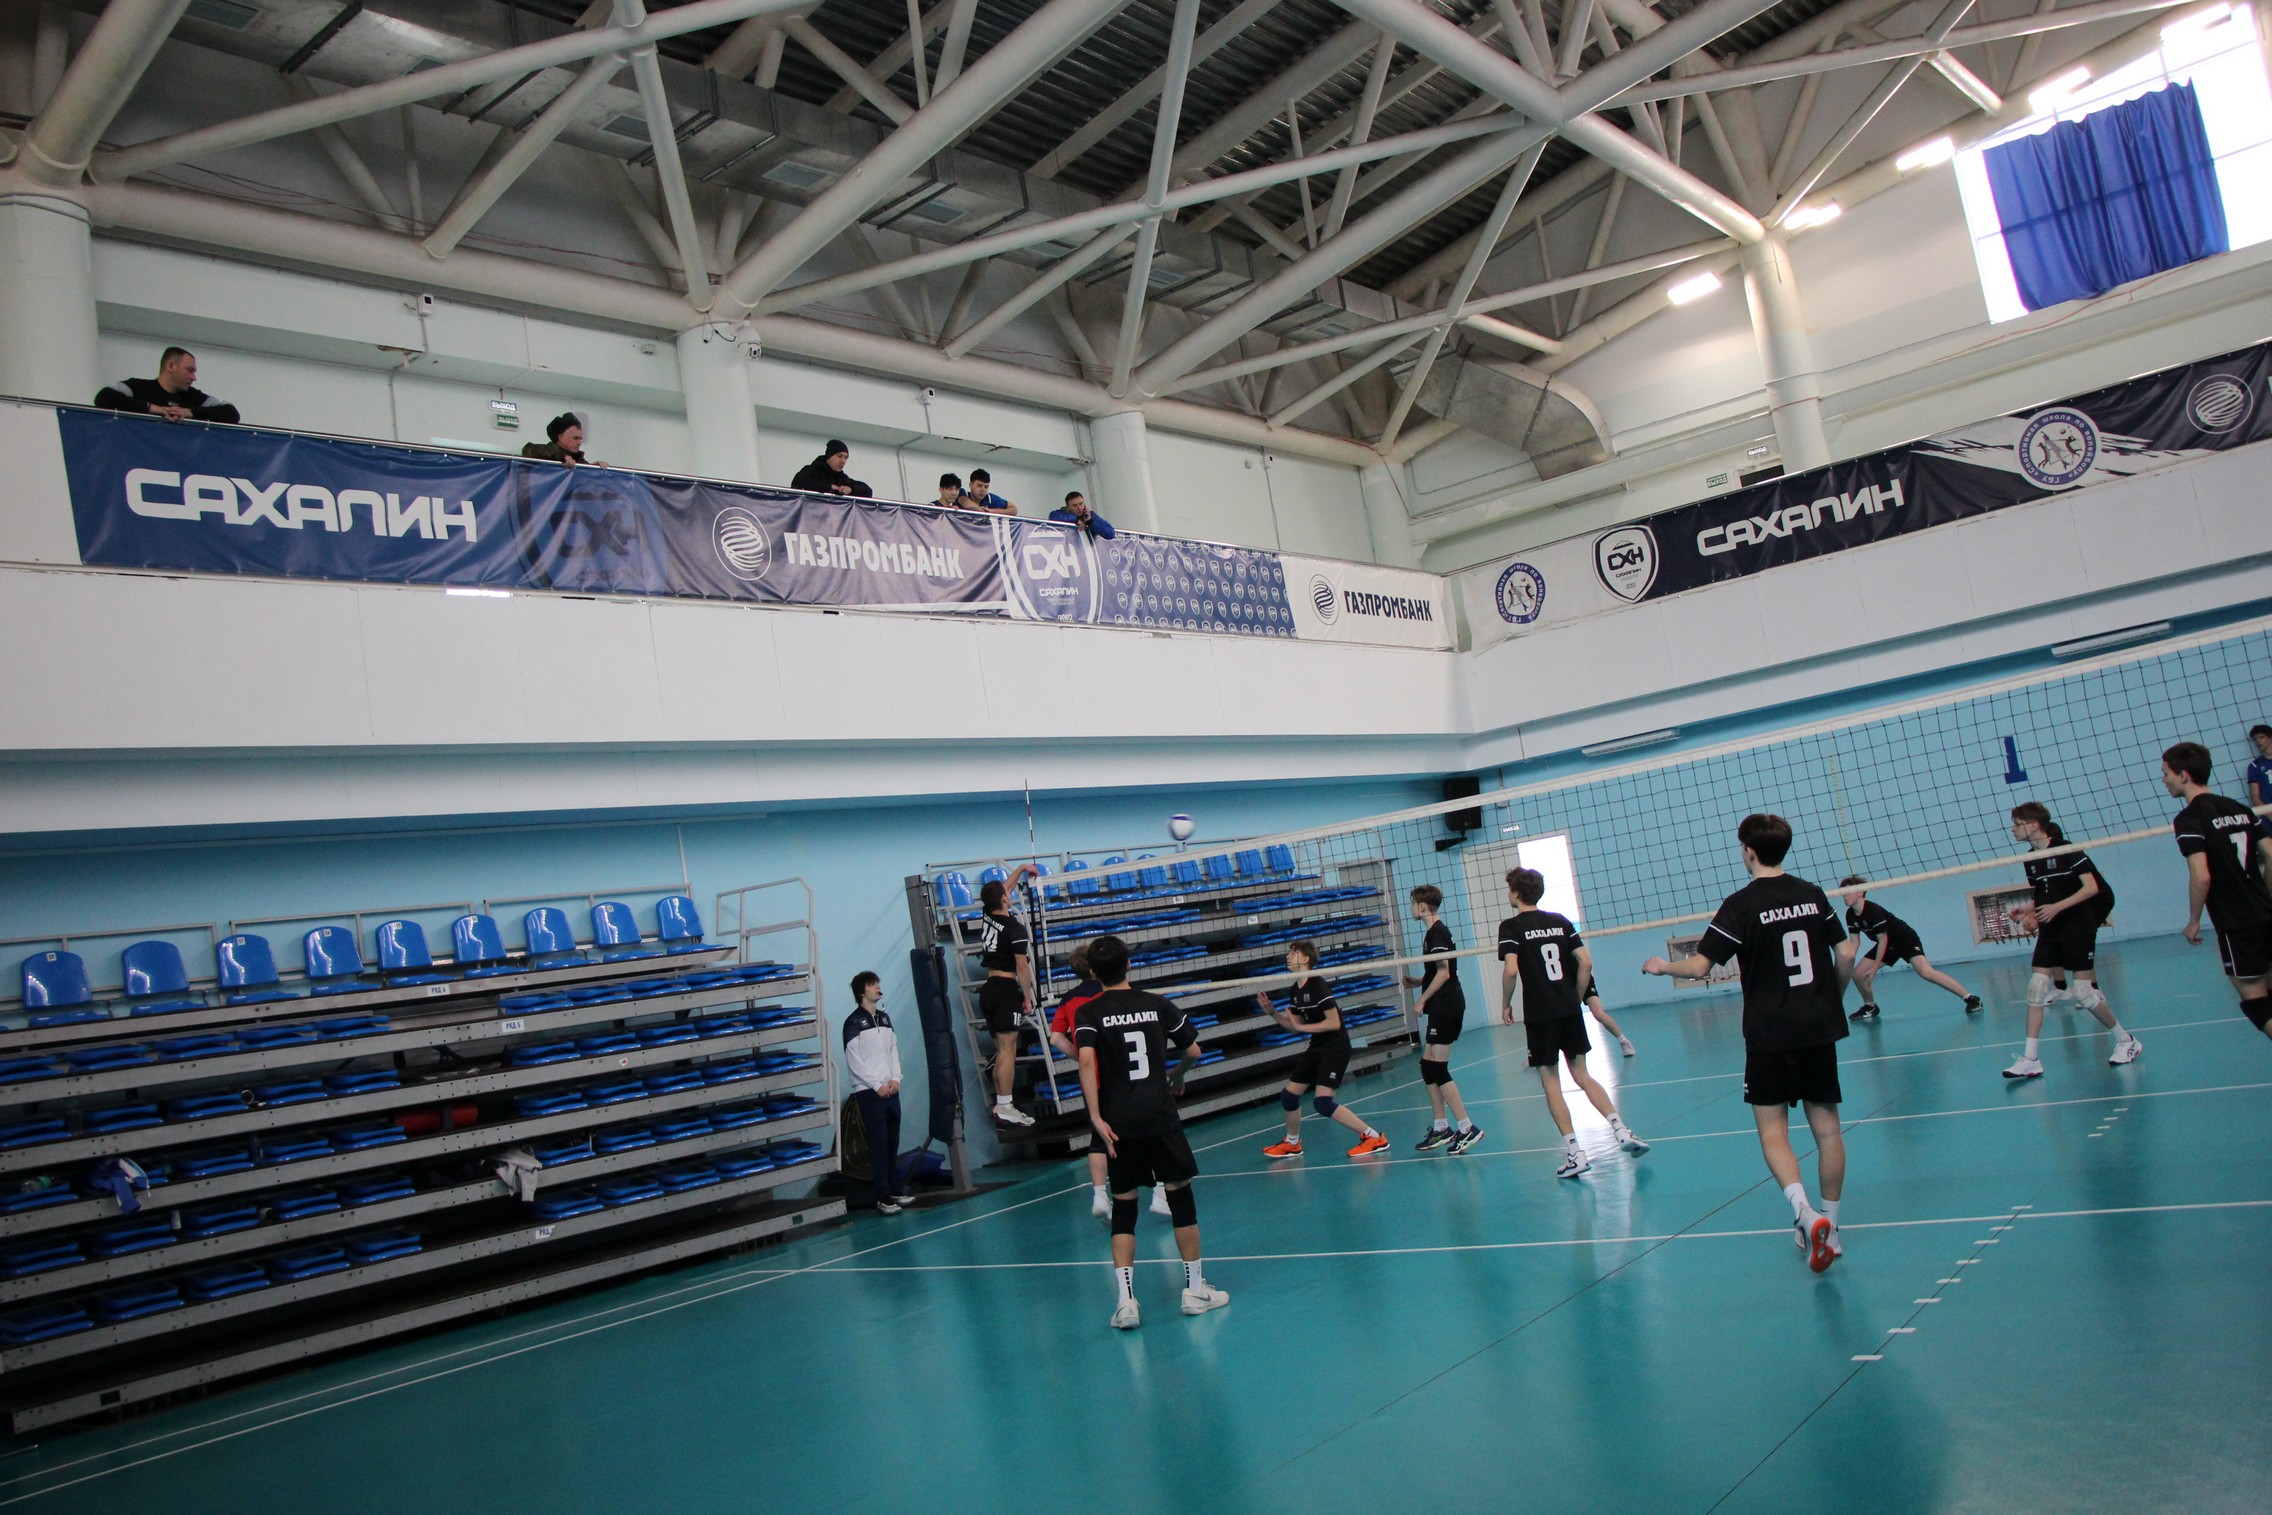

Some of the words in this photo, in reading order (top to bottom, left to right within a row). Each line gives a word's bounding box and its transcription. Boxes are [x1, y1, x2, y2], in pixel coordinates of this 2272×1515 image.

[2042, 414, 2071, 423] школа
[2074, 419, 2085, 428] по
[125, 468, 478, 543] САХАЛИН
[1696, 478, 1905, 557] САХАЛИН
[783, 532, 964, 579] ГАЗПРОМБАНК
[1039, 586, 1079, 597] САХАЛИН
[1344, 590, 1433, 621] ГАЗПРОМБАНК
[2229, 831, 2248, 871] 7
[1759, 903, 1819, 925] САХАЛИН
[1525, 927, 1564, 940] САХАЛИН
[1541, 943, 1563, 981] 8
[1782, 930, 1814, 987] 9
[1102, 1011, 1159, 1027] САХАЛИН
[1124, 1031, 1150, 1080] 3
